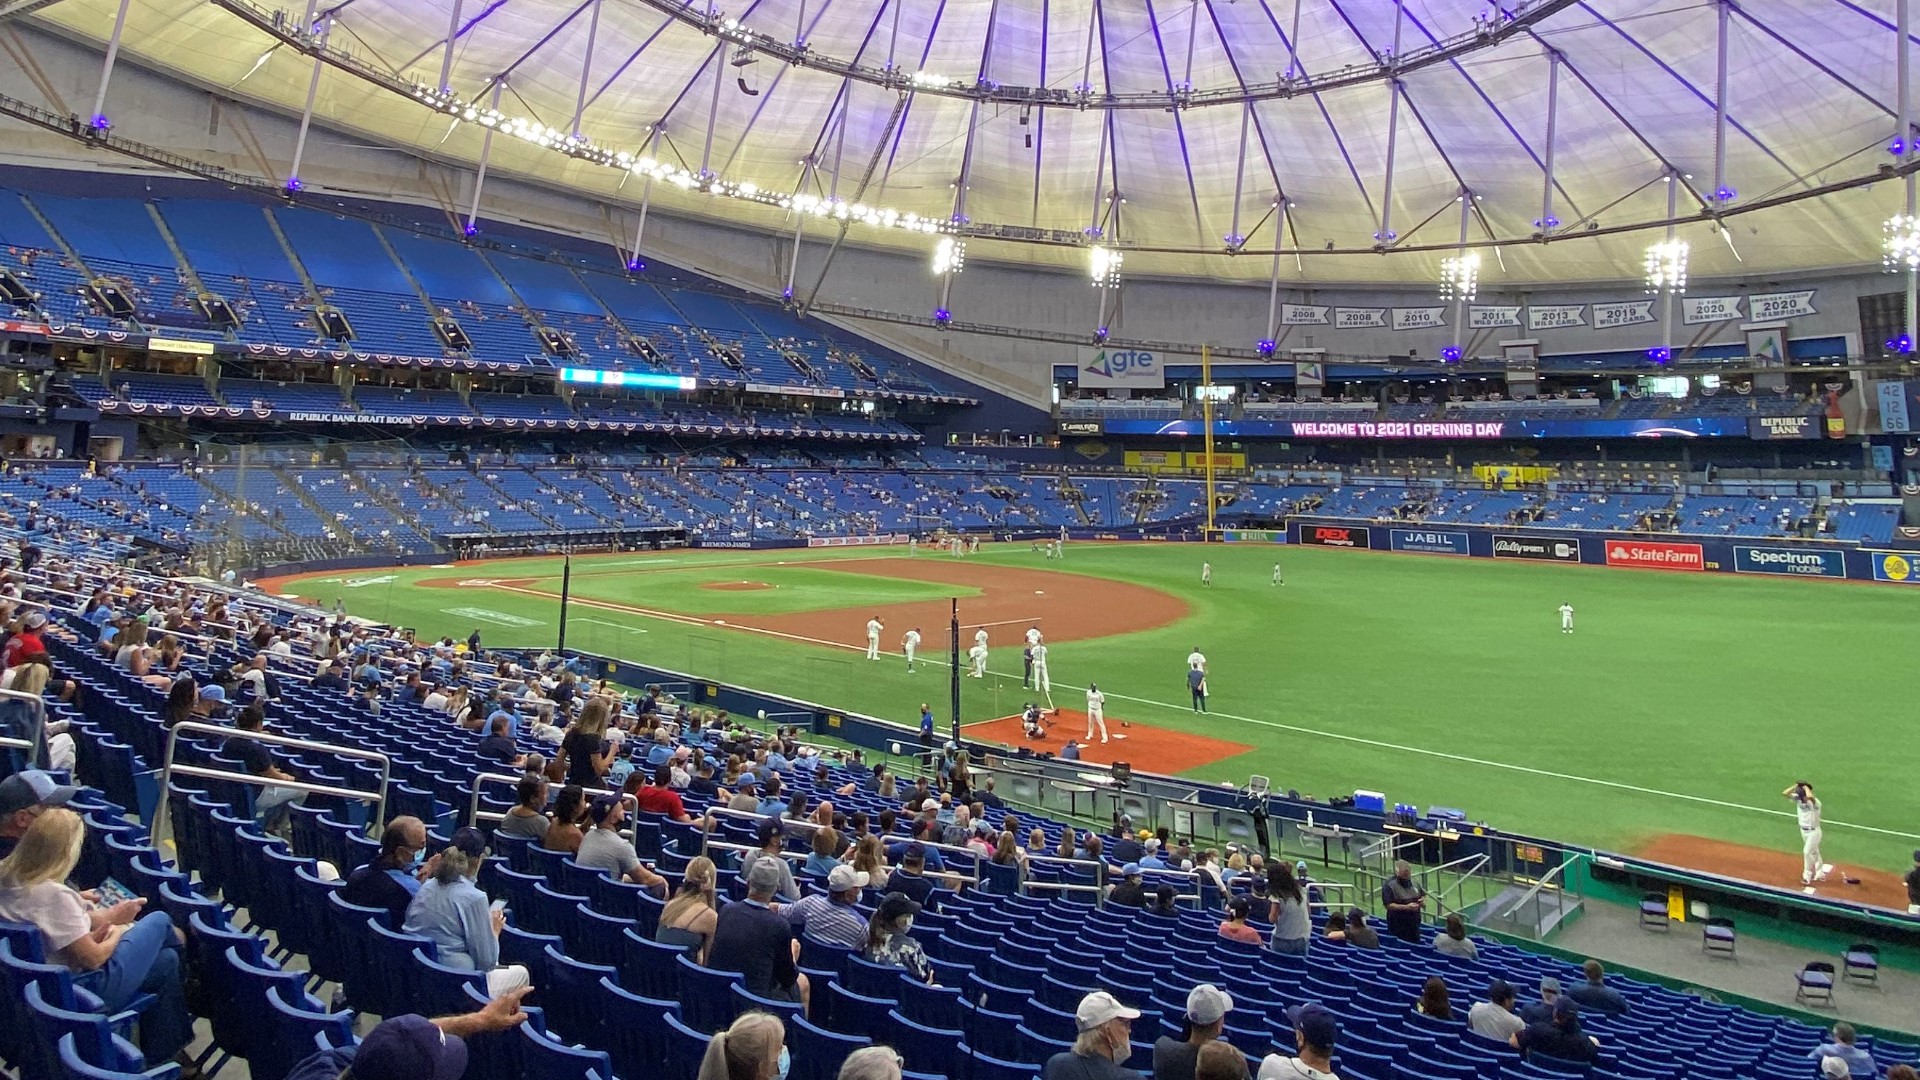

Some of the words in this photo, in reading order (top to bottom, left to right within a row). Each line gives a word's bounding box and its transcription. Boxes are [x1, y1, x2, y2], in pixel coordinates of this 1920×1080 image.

[1696, 304, 1725, 314] 2020
[1763, 299, 1797, 311] 2020
[1346, 313, 1372, 321] 2008
[1404, 313, 1430, 322] 2010
[1481, 312, 1506, 320] 2011
[1541, 311, 1569, 321] 2013
[1606, 308, 1636, 318] 2019
[1755, 308, 1807, 318] CHAMPIONS
[1555, 318, 1578, 326] CARD
[1622, 315, 1646, 323] CARD
[1112, 349, 1153, 372] gte
[1882, 385, 1900, 397] 42
[1886, 400, 1900, 413] 12
[289, 412, 331, 422] REPUBLIC
[331, 414, 356, 423] BANK
[357, 415, 385, 424] DRAFT
[386, 415, 413, 425] ROOM
[1760, 417, 1809, 426] REPUBLIC
[1886, 417, 1904, 429] 66
[1291, 422, 1357, 436] WELCOME
[1358, 423, 1376, 436] TO
[1377, 423, 1411, 436] 2021
[1413, 423, 1473, 436] OPENING
[1475, 423, 1503, 436] DAY
[1771, 425, 1800, 434] BANK
[1315, 528, 1350, 540] DEX
[1405, 533, 1453, 544] JABIL
[1495, 540, 1522, 554] Bally
[1749, 549, 1821, 565] Spectrum
[1787, 564, 1822, 573] mobile
